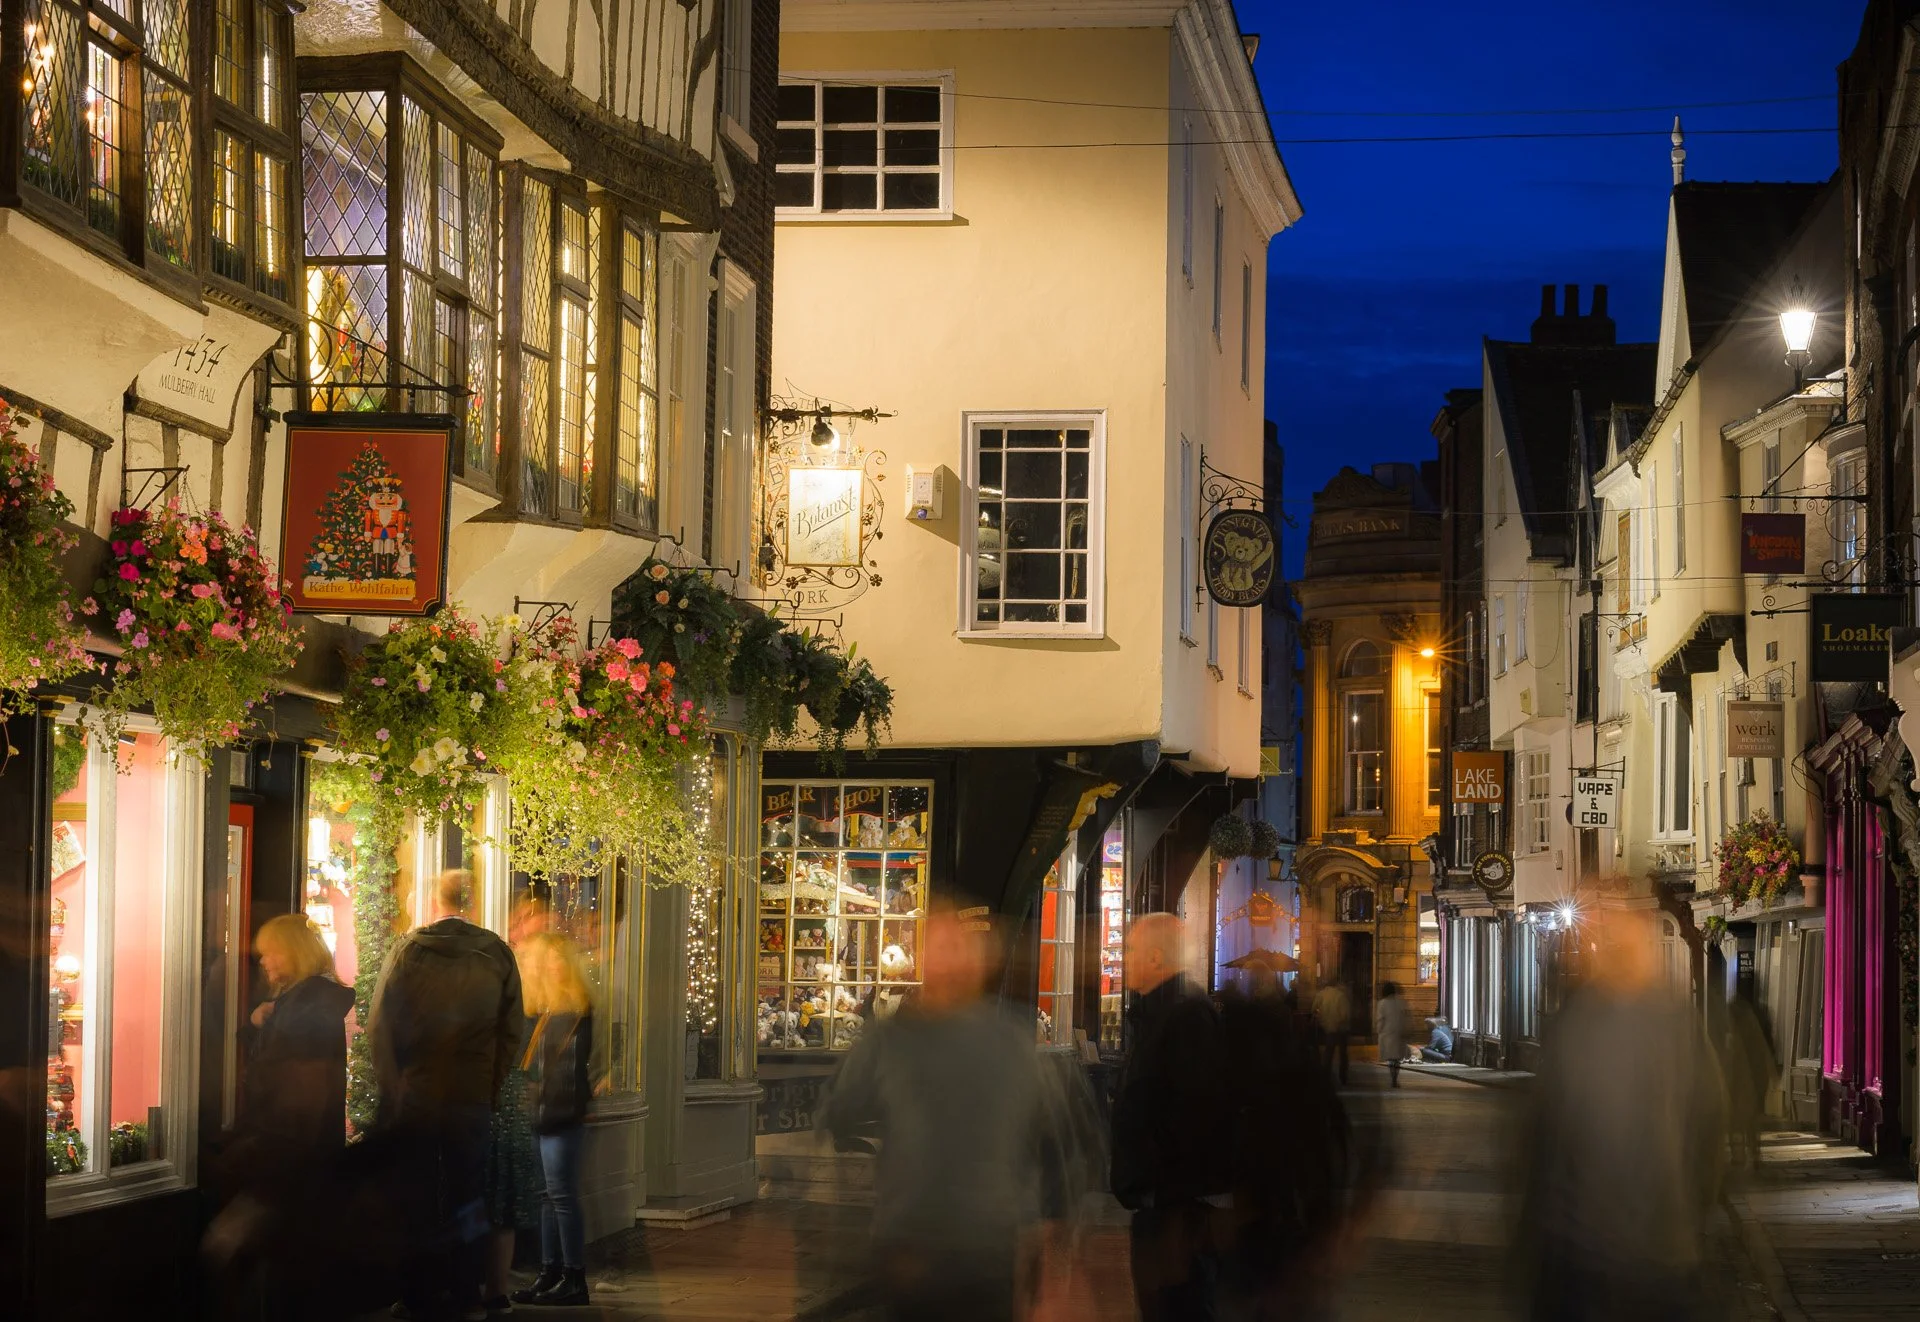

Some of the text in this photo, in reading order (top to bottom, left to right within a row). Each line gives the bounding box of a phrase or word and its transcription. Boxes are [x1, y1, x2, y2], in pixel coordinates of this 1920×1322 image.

[174, 332, 230, 378] 1434
[159, 373, 216, 404] MULBERRY HALL
[1359, 519, 1400, 533] BANK
[1213, 517, 1268, 560] STONEGATE
[309, 581, 410, 595] Käthe Wohlfahrt
[1212, 576, 1267, 601] TEDDY BEARS
[781, 588, 829, 604] YORK
[1735, 721, 1776, 736] werk
[1455, 768, 1496, 784] LAKE
[1455, 784, 1502, 799] LAND
[1578, 782, 1613, 796] VAPE
[767, 786, 881, 811] BEAR SHOP
[1590, 797, 1599, 810] &
[1581, 811, 1608, 824] CBD
